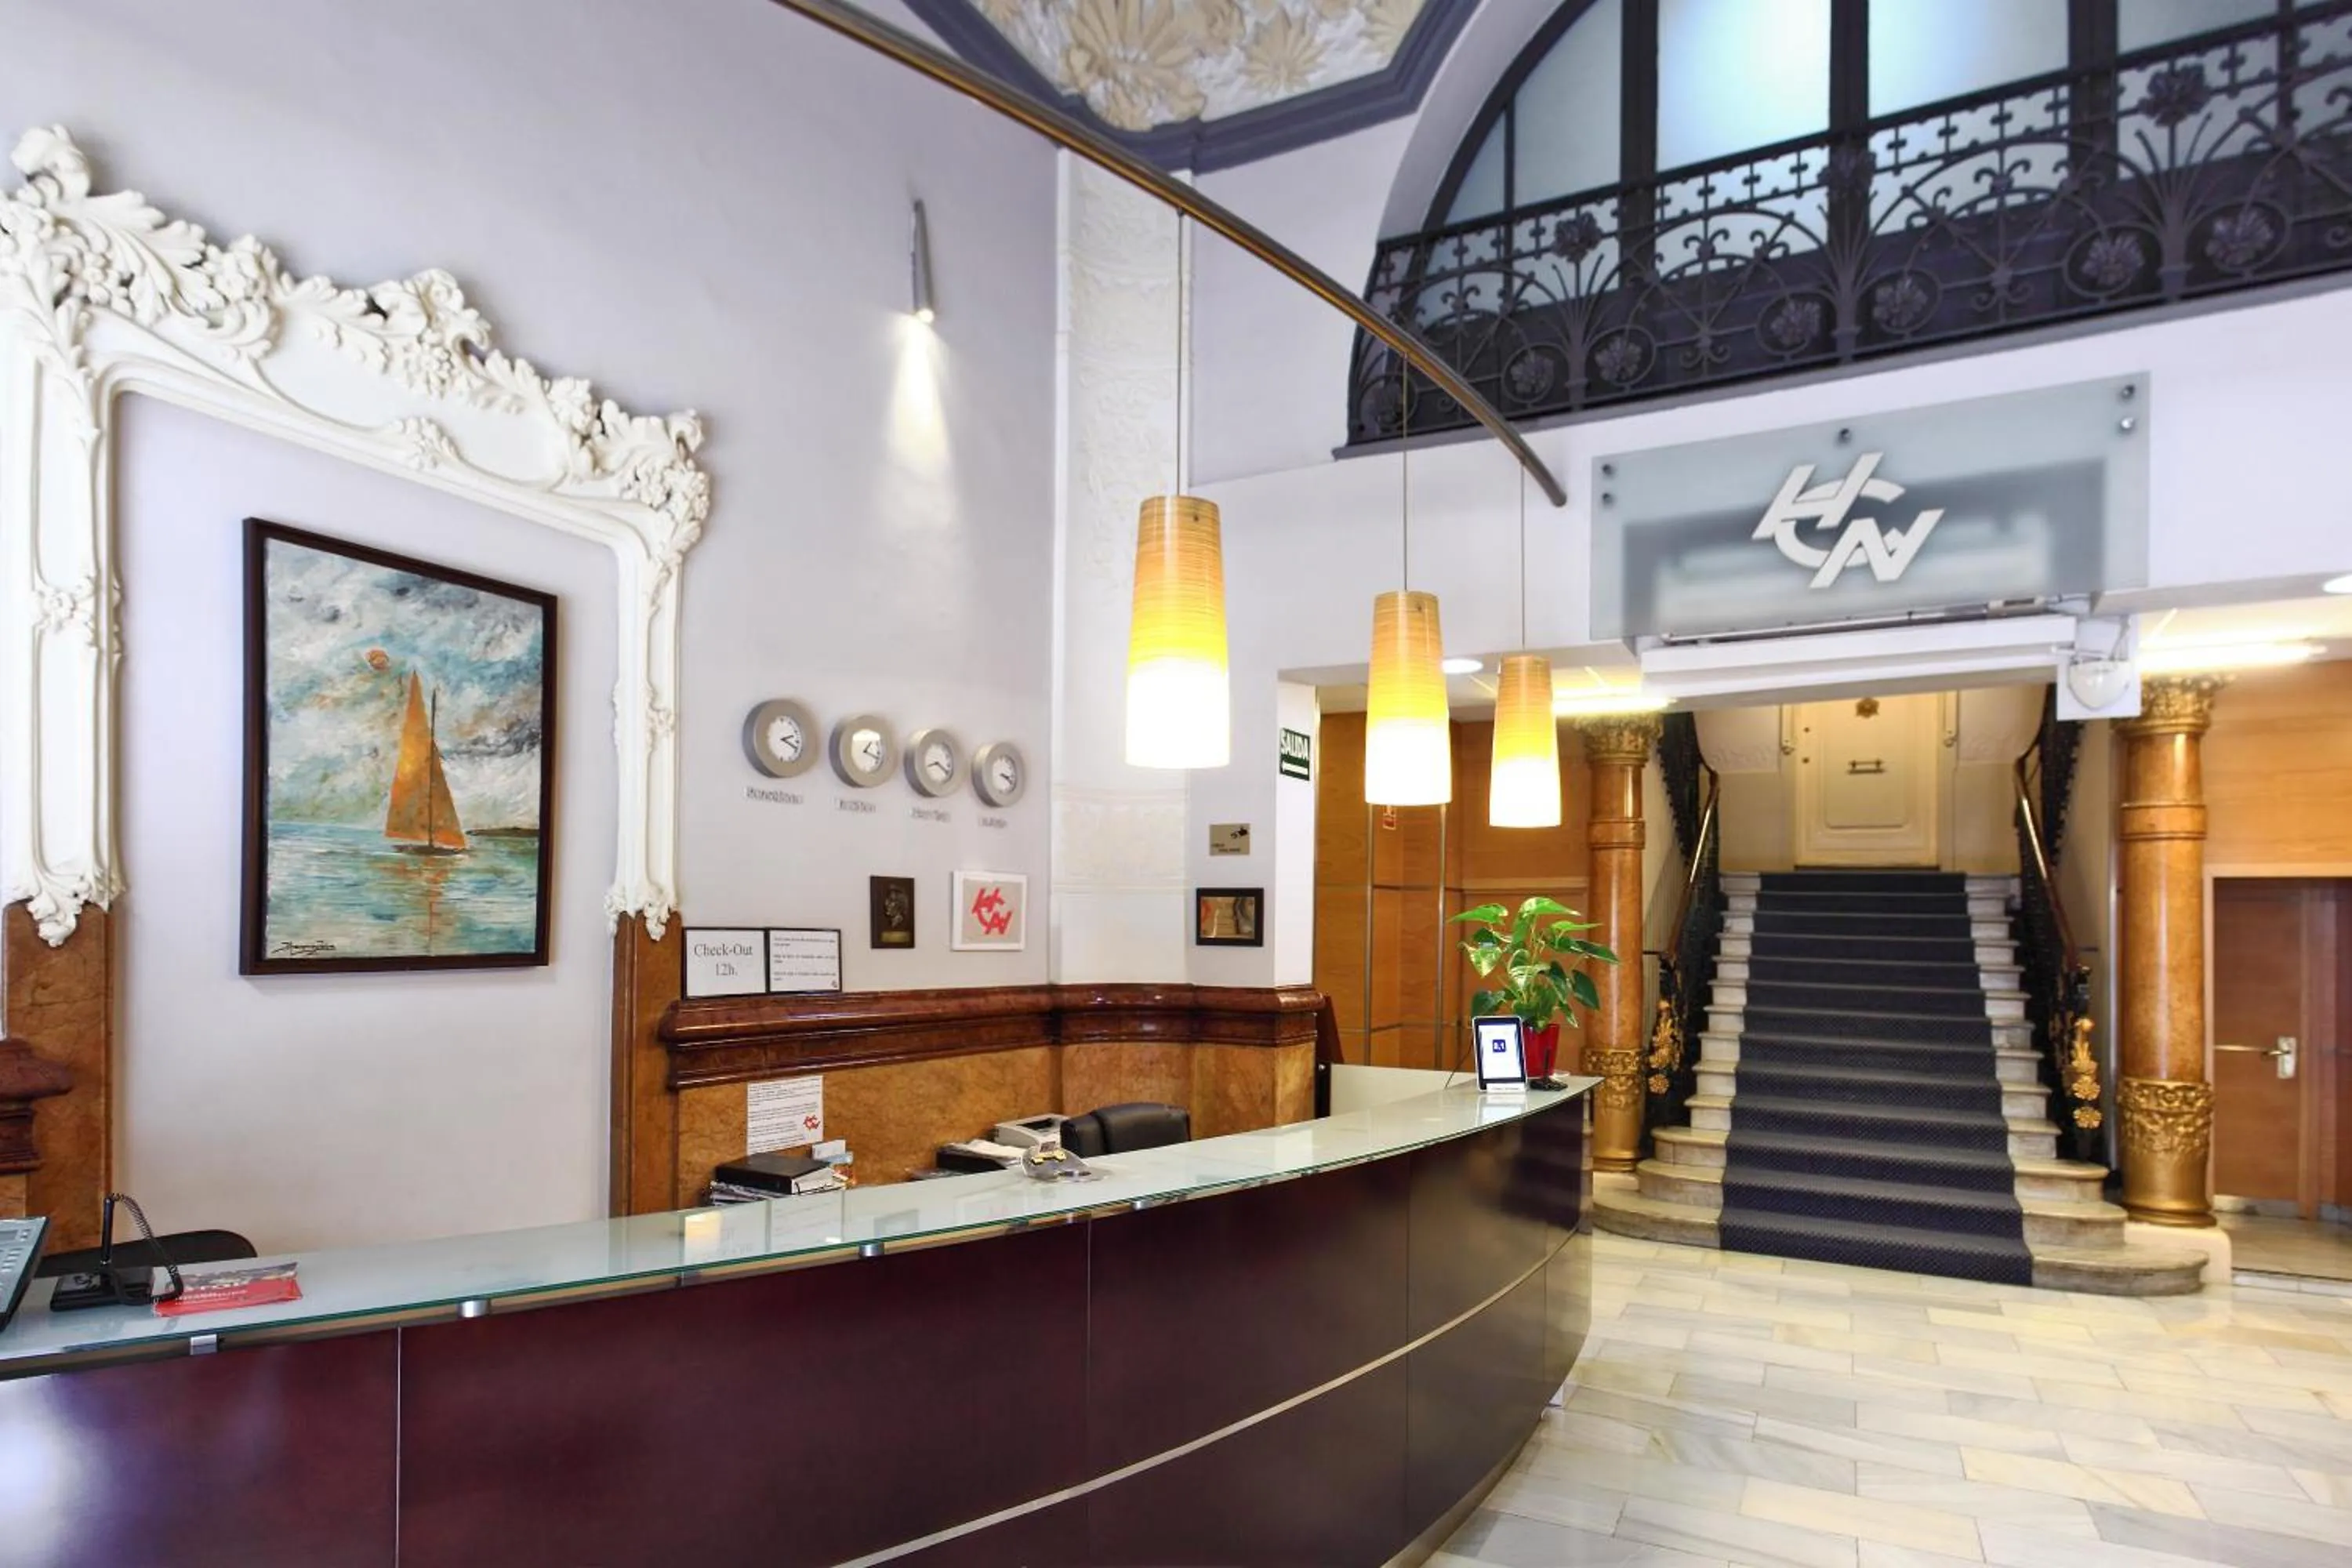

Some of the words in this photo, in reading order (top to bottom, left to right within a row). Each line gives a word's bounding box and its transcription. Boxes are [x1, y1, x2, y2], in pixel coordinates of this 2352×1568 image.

[1280, 730, 1308, 760] SALIDA
[694, 943, 753, 957] Check-Out
[716, 963, 738, 977] 12h.
